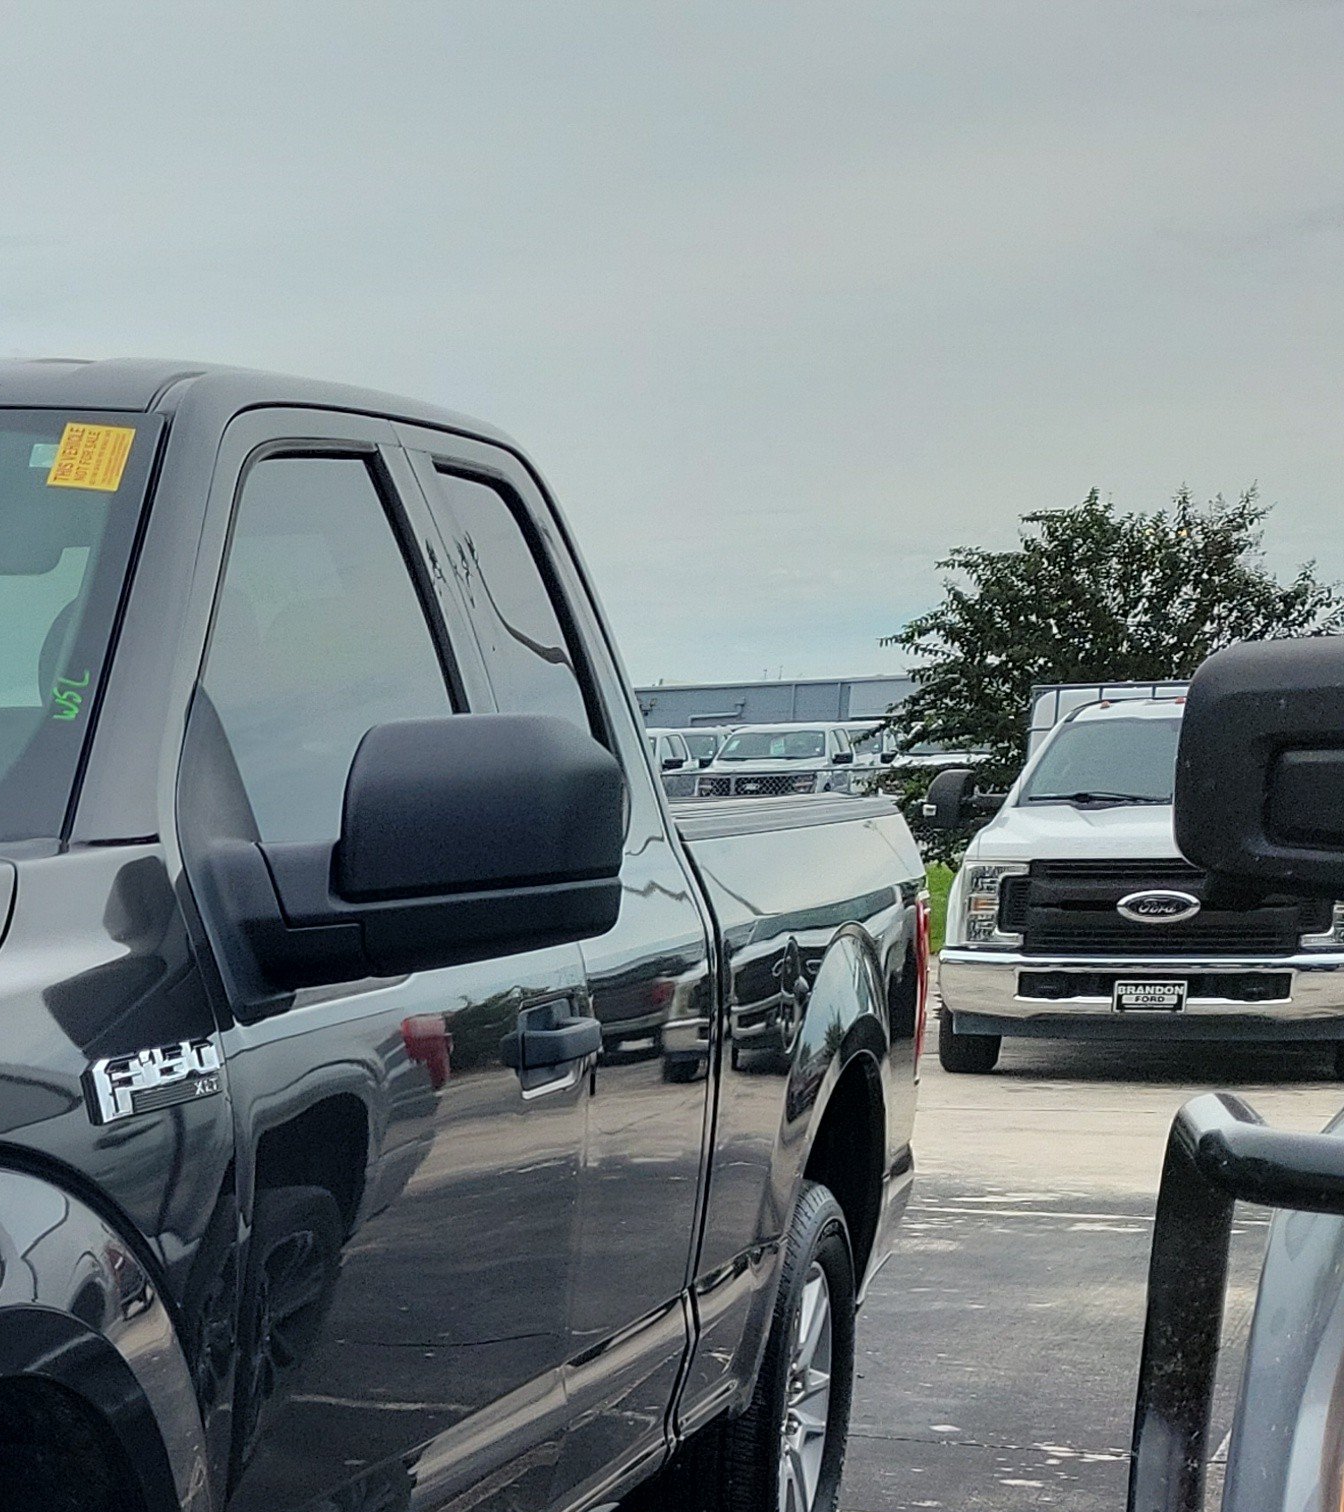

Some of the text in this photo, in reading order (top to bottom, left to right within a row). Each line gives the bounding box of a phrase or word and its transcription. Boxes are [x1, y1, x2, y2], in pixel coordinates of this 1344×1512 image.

[1138, 898, 1177, 914] Ford
[1117, 985, 1184, 995] BRANDON
[1134, 995, 1165, 1003] FORD
[194, 1077, 219, 1095] XLT
